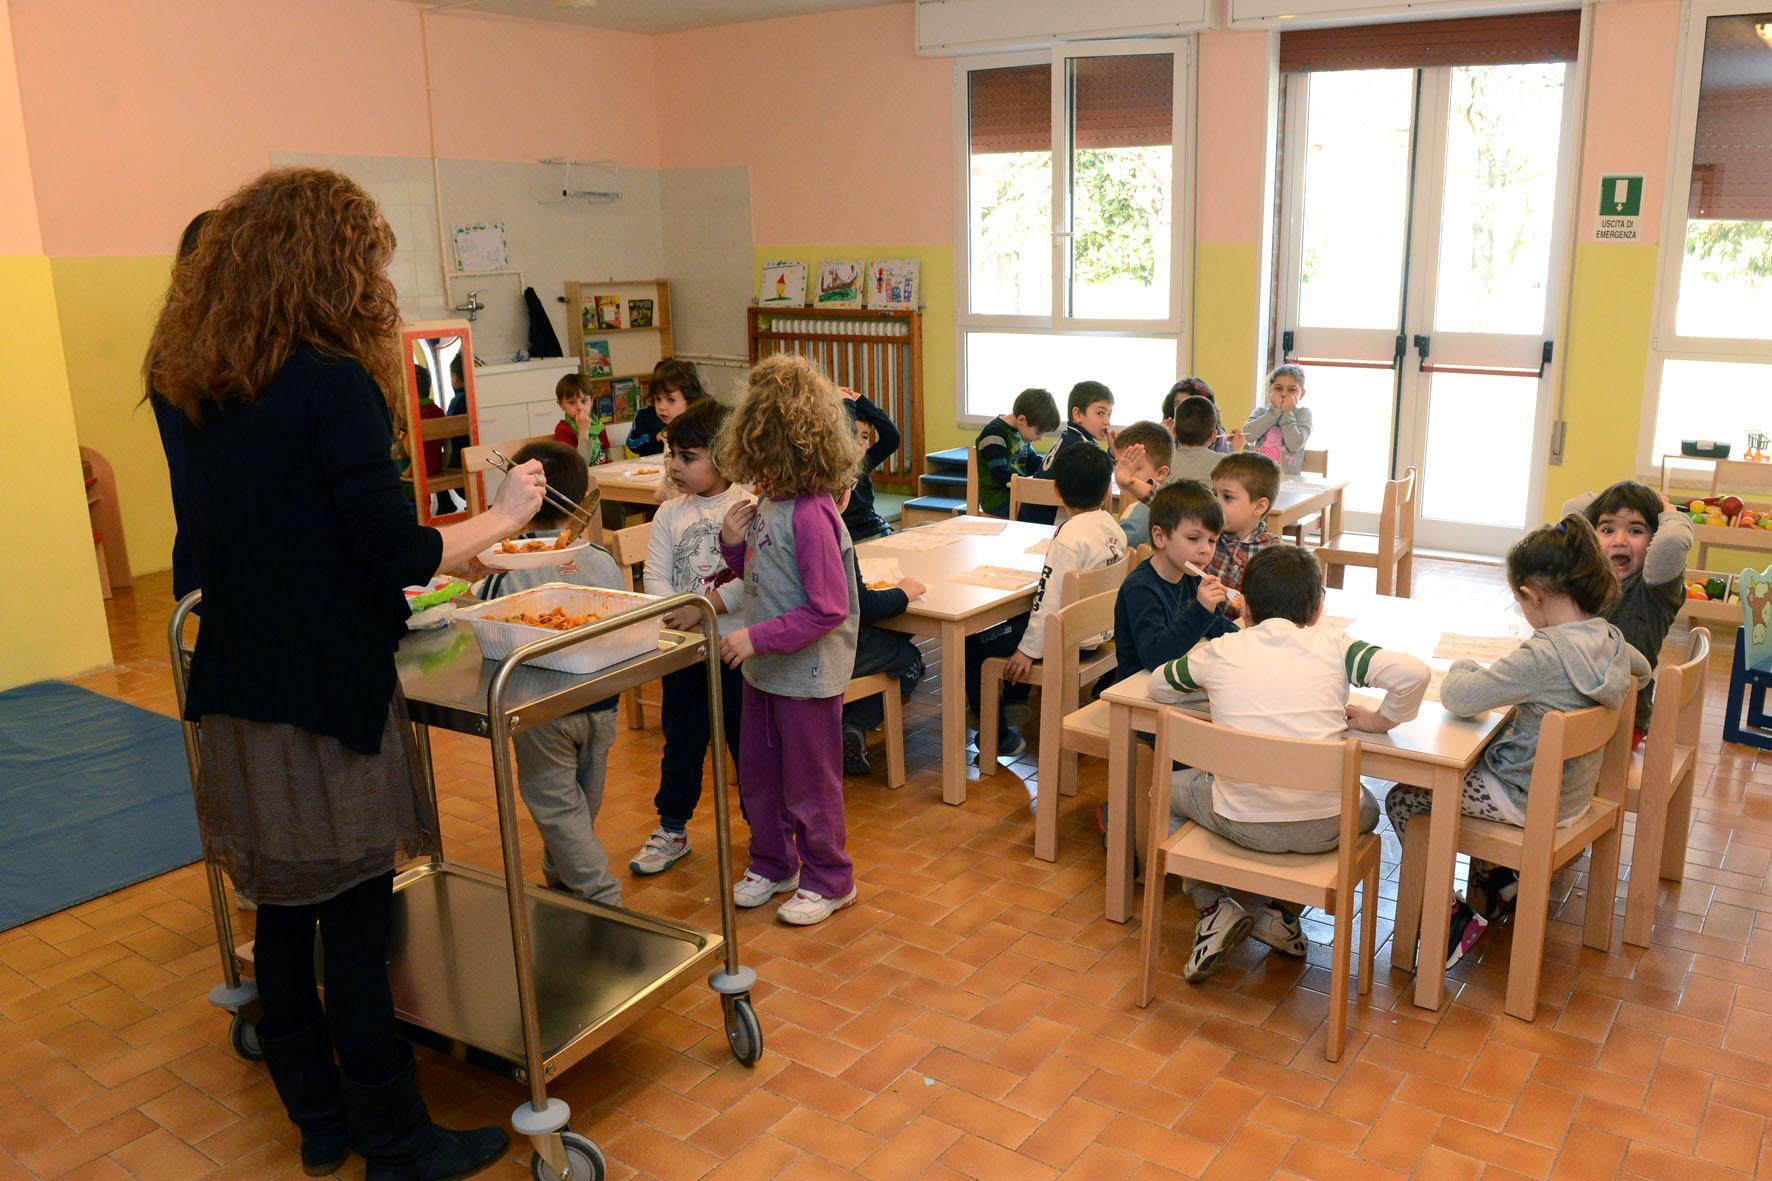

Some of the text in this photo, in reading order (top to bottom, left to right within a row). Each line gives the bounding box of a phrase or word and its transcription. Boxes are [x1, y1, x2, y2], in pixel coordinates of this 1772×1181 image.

[1602, 220, 1633, 228] USCITA DI
[1596, 230, 1636, 238] EMERGENZA
